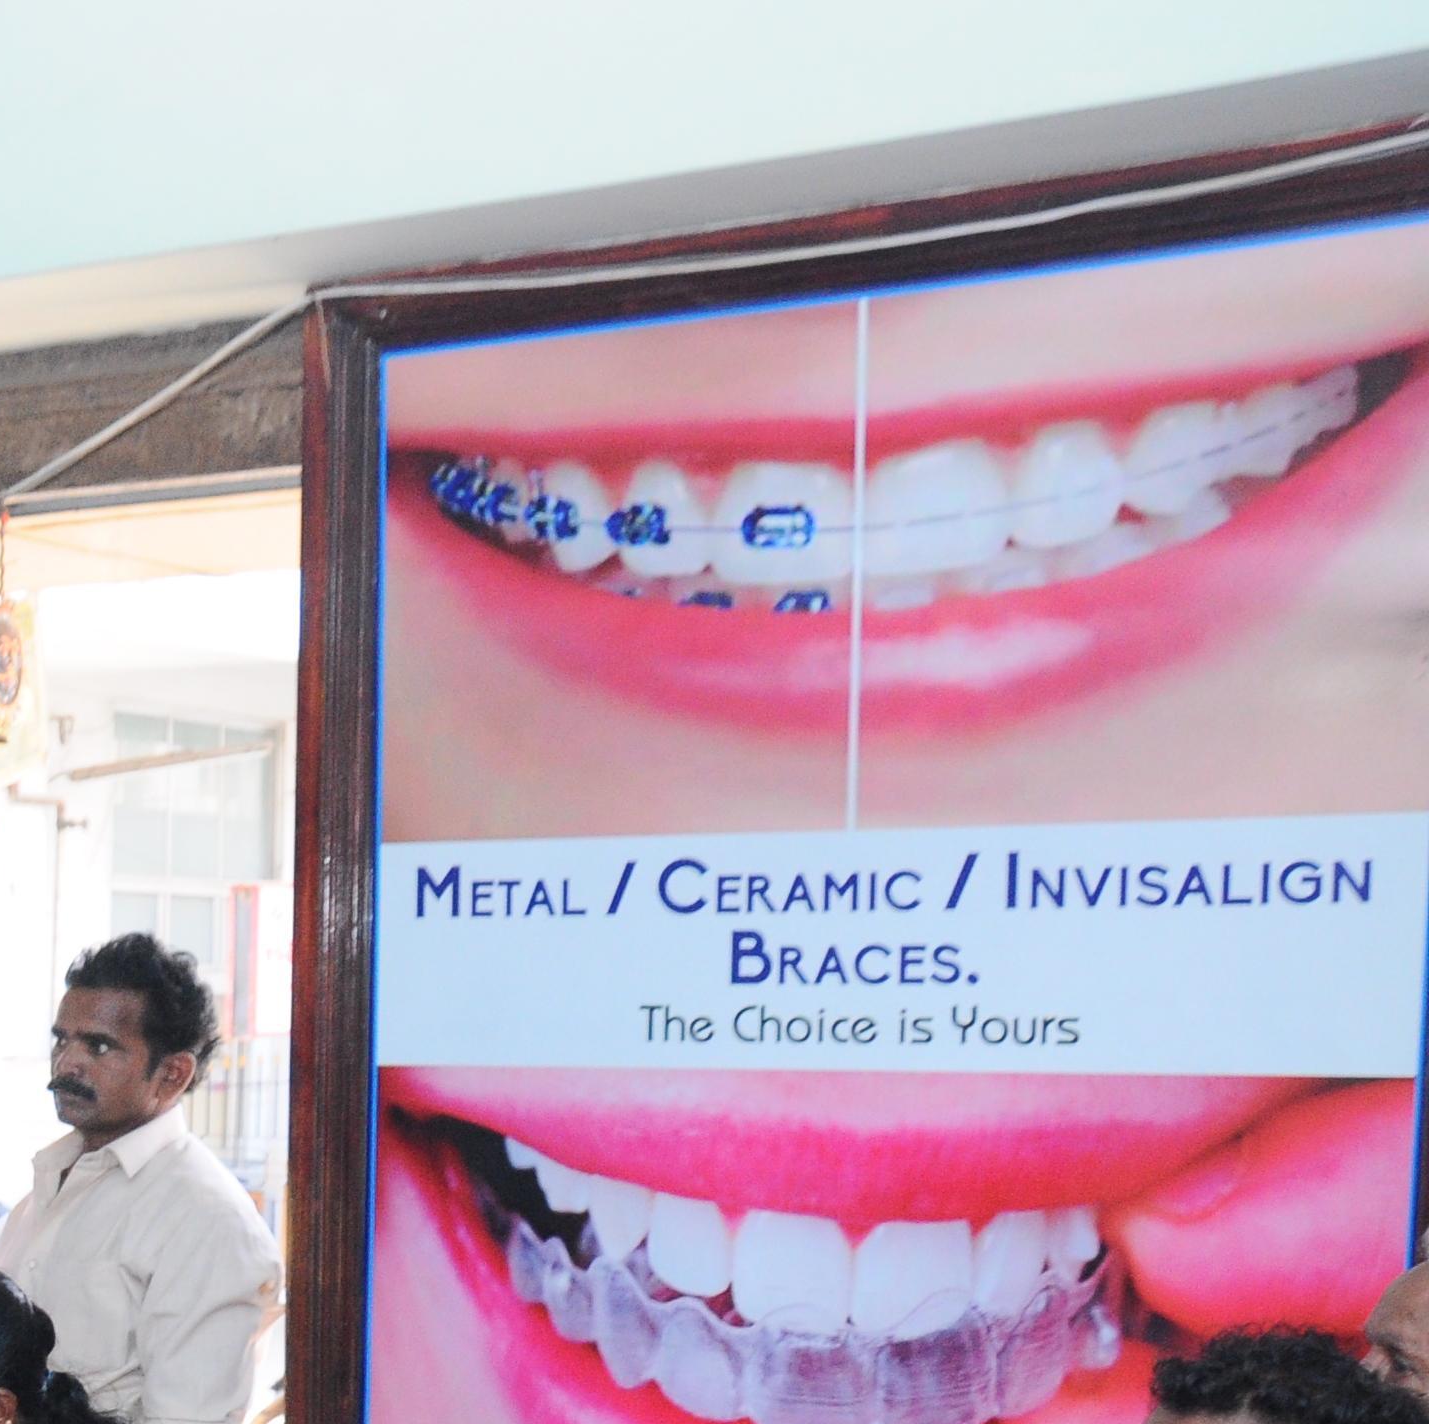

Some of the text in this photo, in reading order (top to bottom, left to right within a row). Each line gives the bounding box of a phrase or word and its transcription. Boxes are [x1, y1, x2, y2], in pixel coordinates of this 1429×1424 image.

[606, 859, 637, 916] /
[944, 852, 979, 911] /
[638, 1004, 1082, 1048] The Choice is Yours
